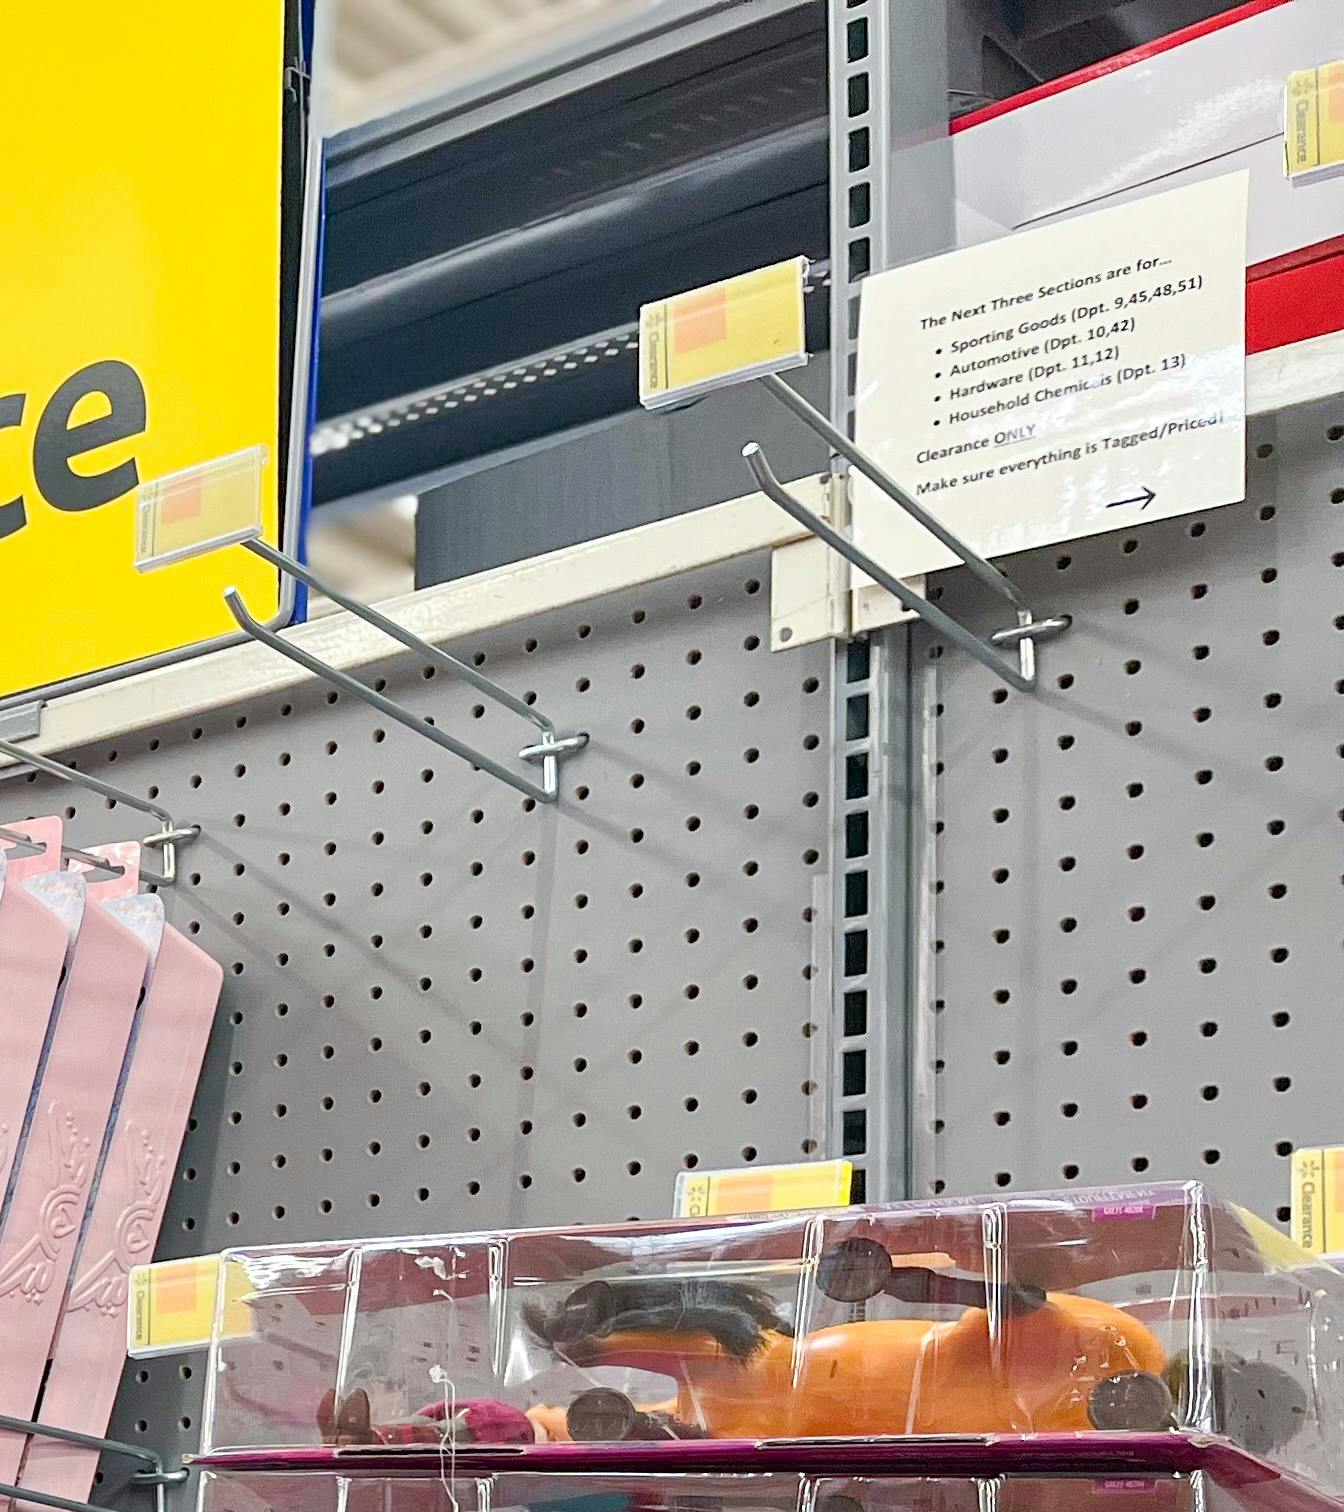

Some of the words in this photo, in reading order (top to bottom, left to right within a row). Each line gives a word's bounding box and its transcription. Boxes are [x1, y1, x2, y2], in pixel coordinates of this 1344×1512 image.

[920, 315, 947, 330] The
[951, 303, 986, 322] Next
[990, 291, 1034, 311] Three
[1037, 273, 1102, 299] Sections
[1106, 265, 1132, 280] are
[950, 328, 1015, 354] Sporting
[1018, 313, 1067, 335] Goods
[1071, 302, 1110, 323] (Dpt.
[1114, 274, 1203, 310] 9,45,48,51)
[949, 345, 1040, 377] Automotive
[1044, 333, 1082, 354] (Dpt.
[1087, 316, 1136, 341] 10,42)
[949, 372, 1024, 400] Hardware
[1028, 361, 1067, 382] (Dpt.
[1072, 345, 1120, 369] 11,12)
[949, 393, 1031, 425] Household
[1117, 364, 1156, 385] (Dpt.
[1161, 353, 1186, 371] 13)
[916, 438, 990, 464] Clearance
[994, 424, 1036, 446] ONLY
[916, 477, 958, 496] Make
[962, 468, 995, 485] sure
[999, 447, 1082, 476] everything
[1085, 442, 1098, 454] is
[1300, 1181, 1316, 1250] Clearance
